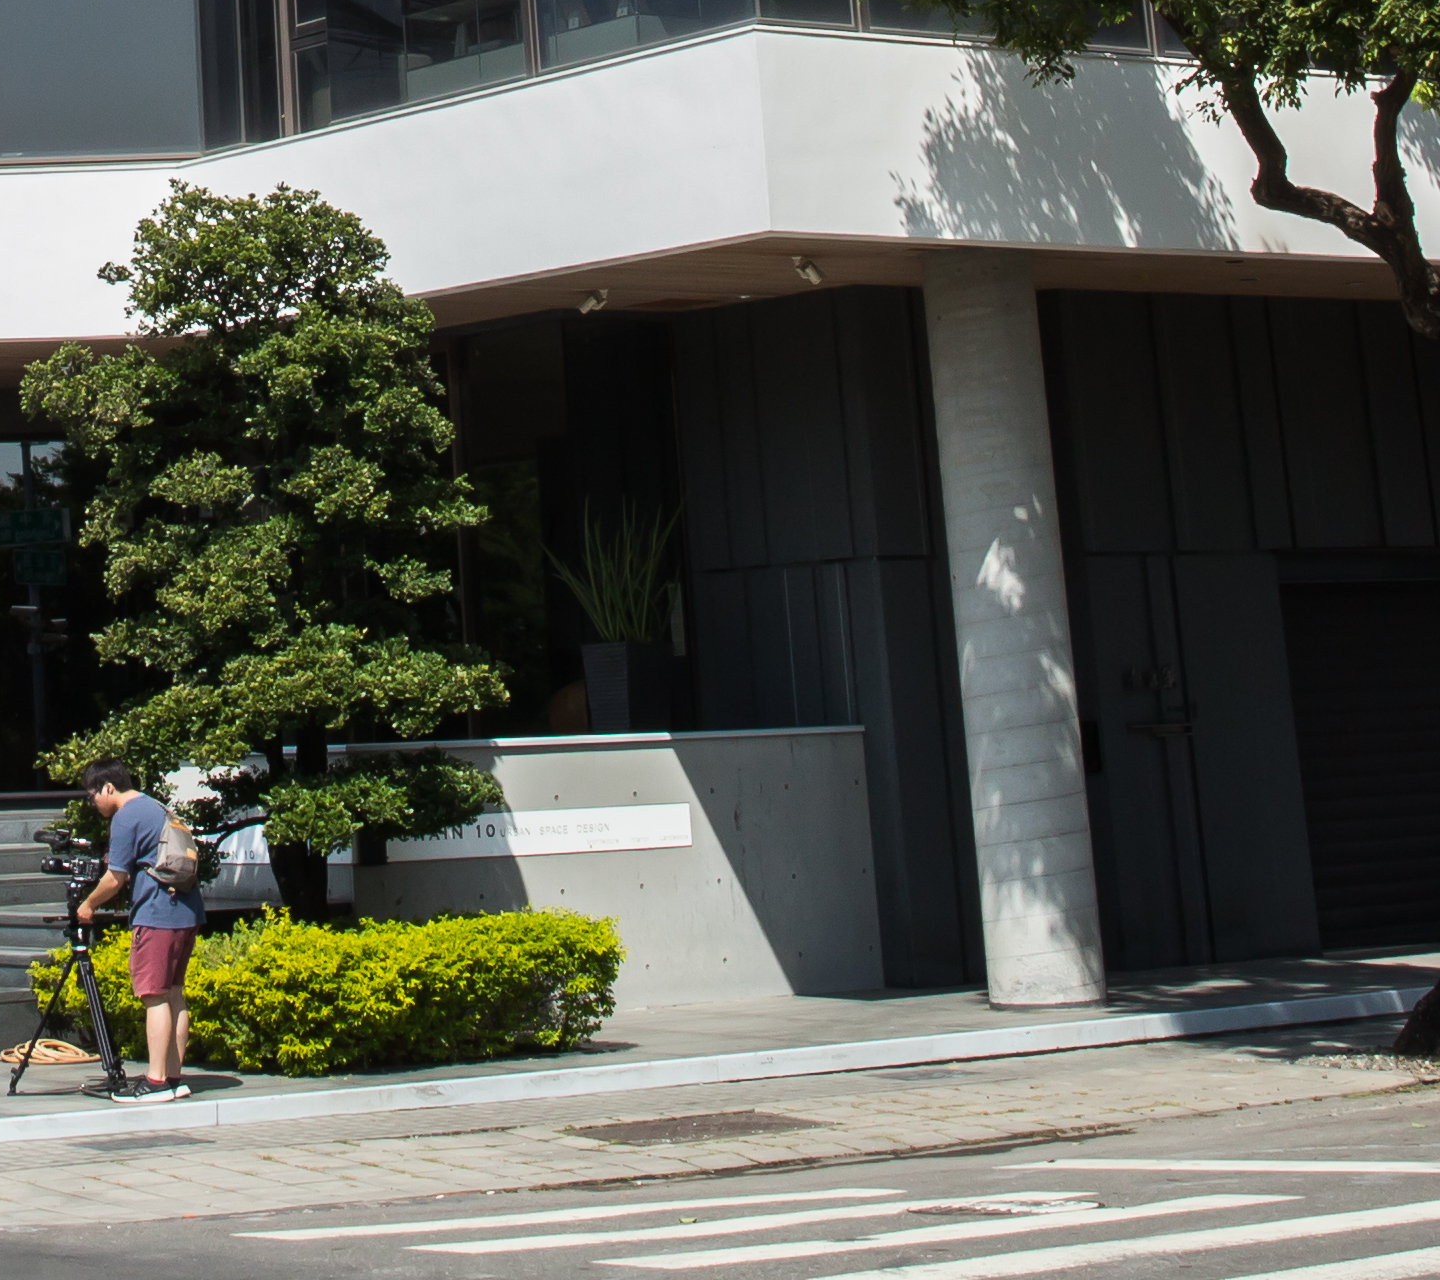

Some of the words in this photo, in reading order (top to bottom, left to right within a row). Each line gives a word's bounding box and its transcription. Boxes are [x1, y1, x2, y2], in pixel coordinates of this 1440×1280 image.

[476, 824, 496, 838] 10
[539, 824, 568, 836] SPACE
[576, 822, 610, 834] DESIGN
